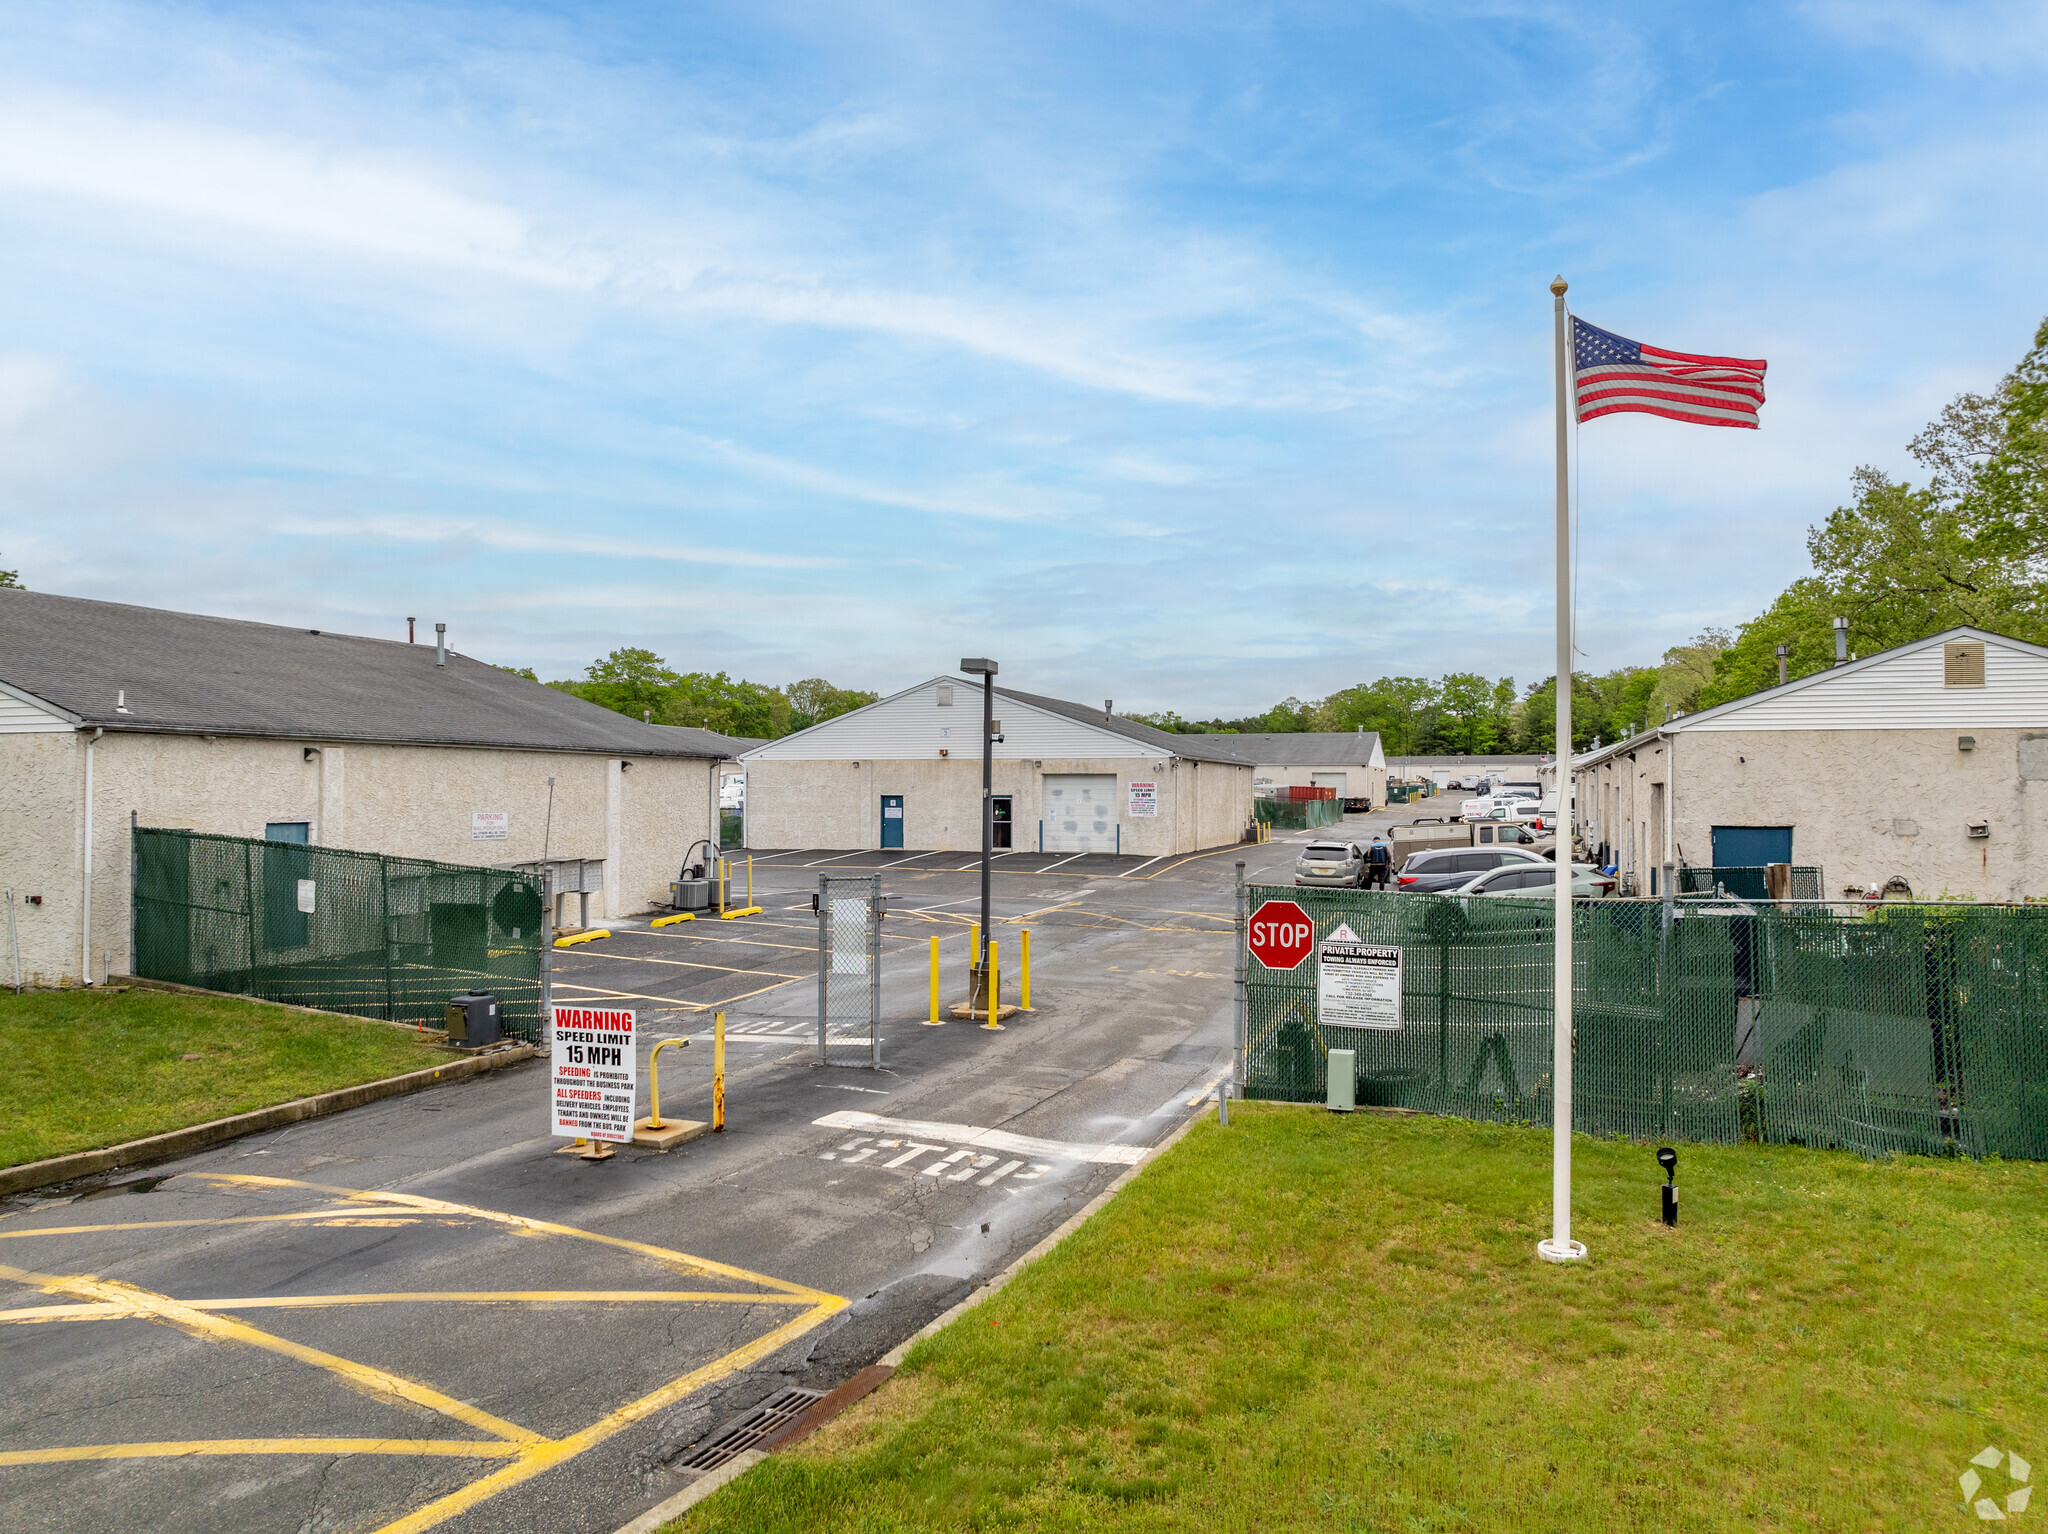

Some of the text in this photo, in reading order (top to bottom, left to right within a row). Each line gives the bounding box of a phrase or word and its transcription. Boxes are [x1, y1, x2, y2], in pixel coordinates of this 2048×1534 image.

[1253, 922, 1309, 948] STOP
[1340, 929, 1347, 938] R
[1323, 945, 1397, 958] PRIVATE PROPERTY
[556, 1009, 632, 1032] WARNING
[556, 1031, 631, 1045] SPEED LIMIT
[566, 1045, 621, 1066] 15 MPH
[559, 1066, 591, 1077] SPEEDING
[600, 1072, 628, 1080] PROHIBITED
[554, 1078, 586, 1086] THROUGHOUT
[596, 1081, 620, 1089] BUSINESS
[557, 1089, 630, 1103] ALL SPEEDERS INCLUDING
[558, 1110, 578, 1118] TENANTS
[590, 1112, 610, 1120] OWNERS
[817, 1137, 1057, 1188] STOP
